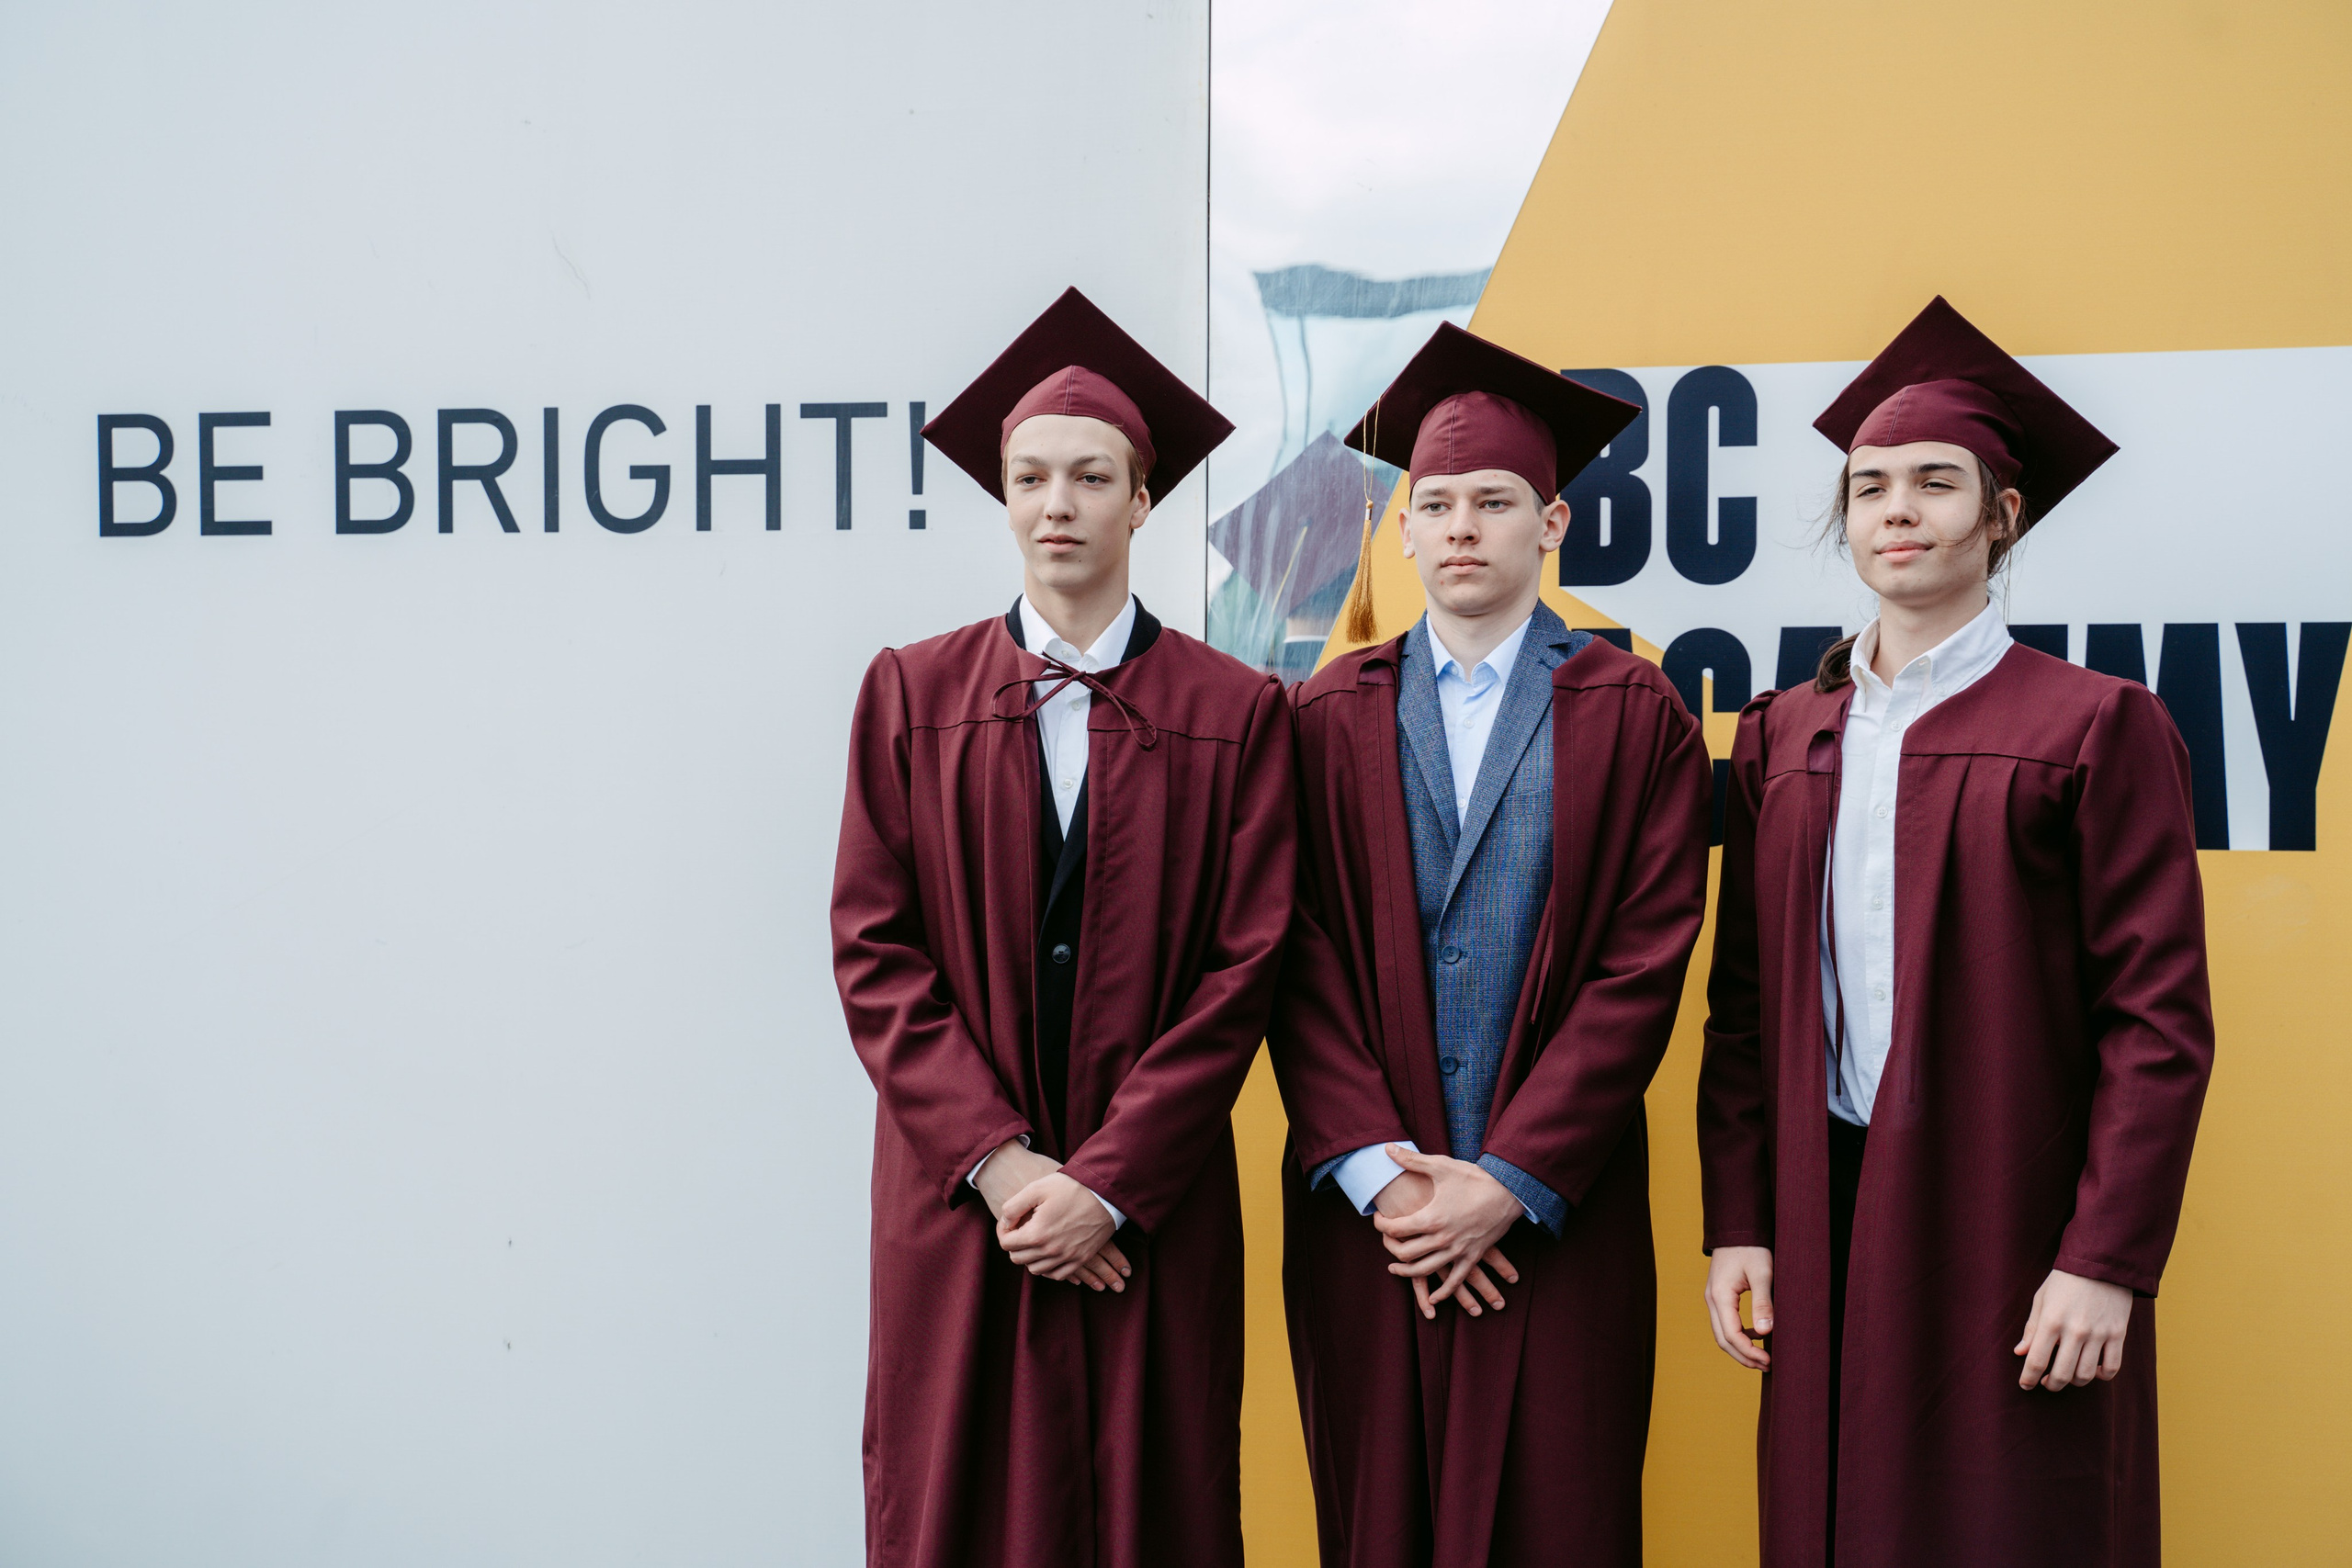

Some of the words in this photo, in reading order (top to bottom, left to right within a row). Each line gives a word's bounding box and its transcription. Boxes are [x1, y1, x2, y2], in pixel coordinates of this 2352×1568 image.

[97, 412, 273, 537] BE
[334, 401, 926, 535] BRIGHT!
[1559, 365, 1758, 587] BC
